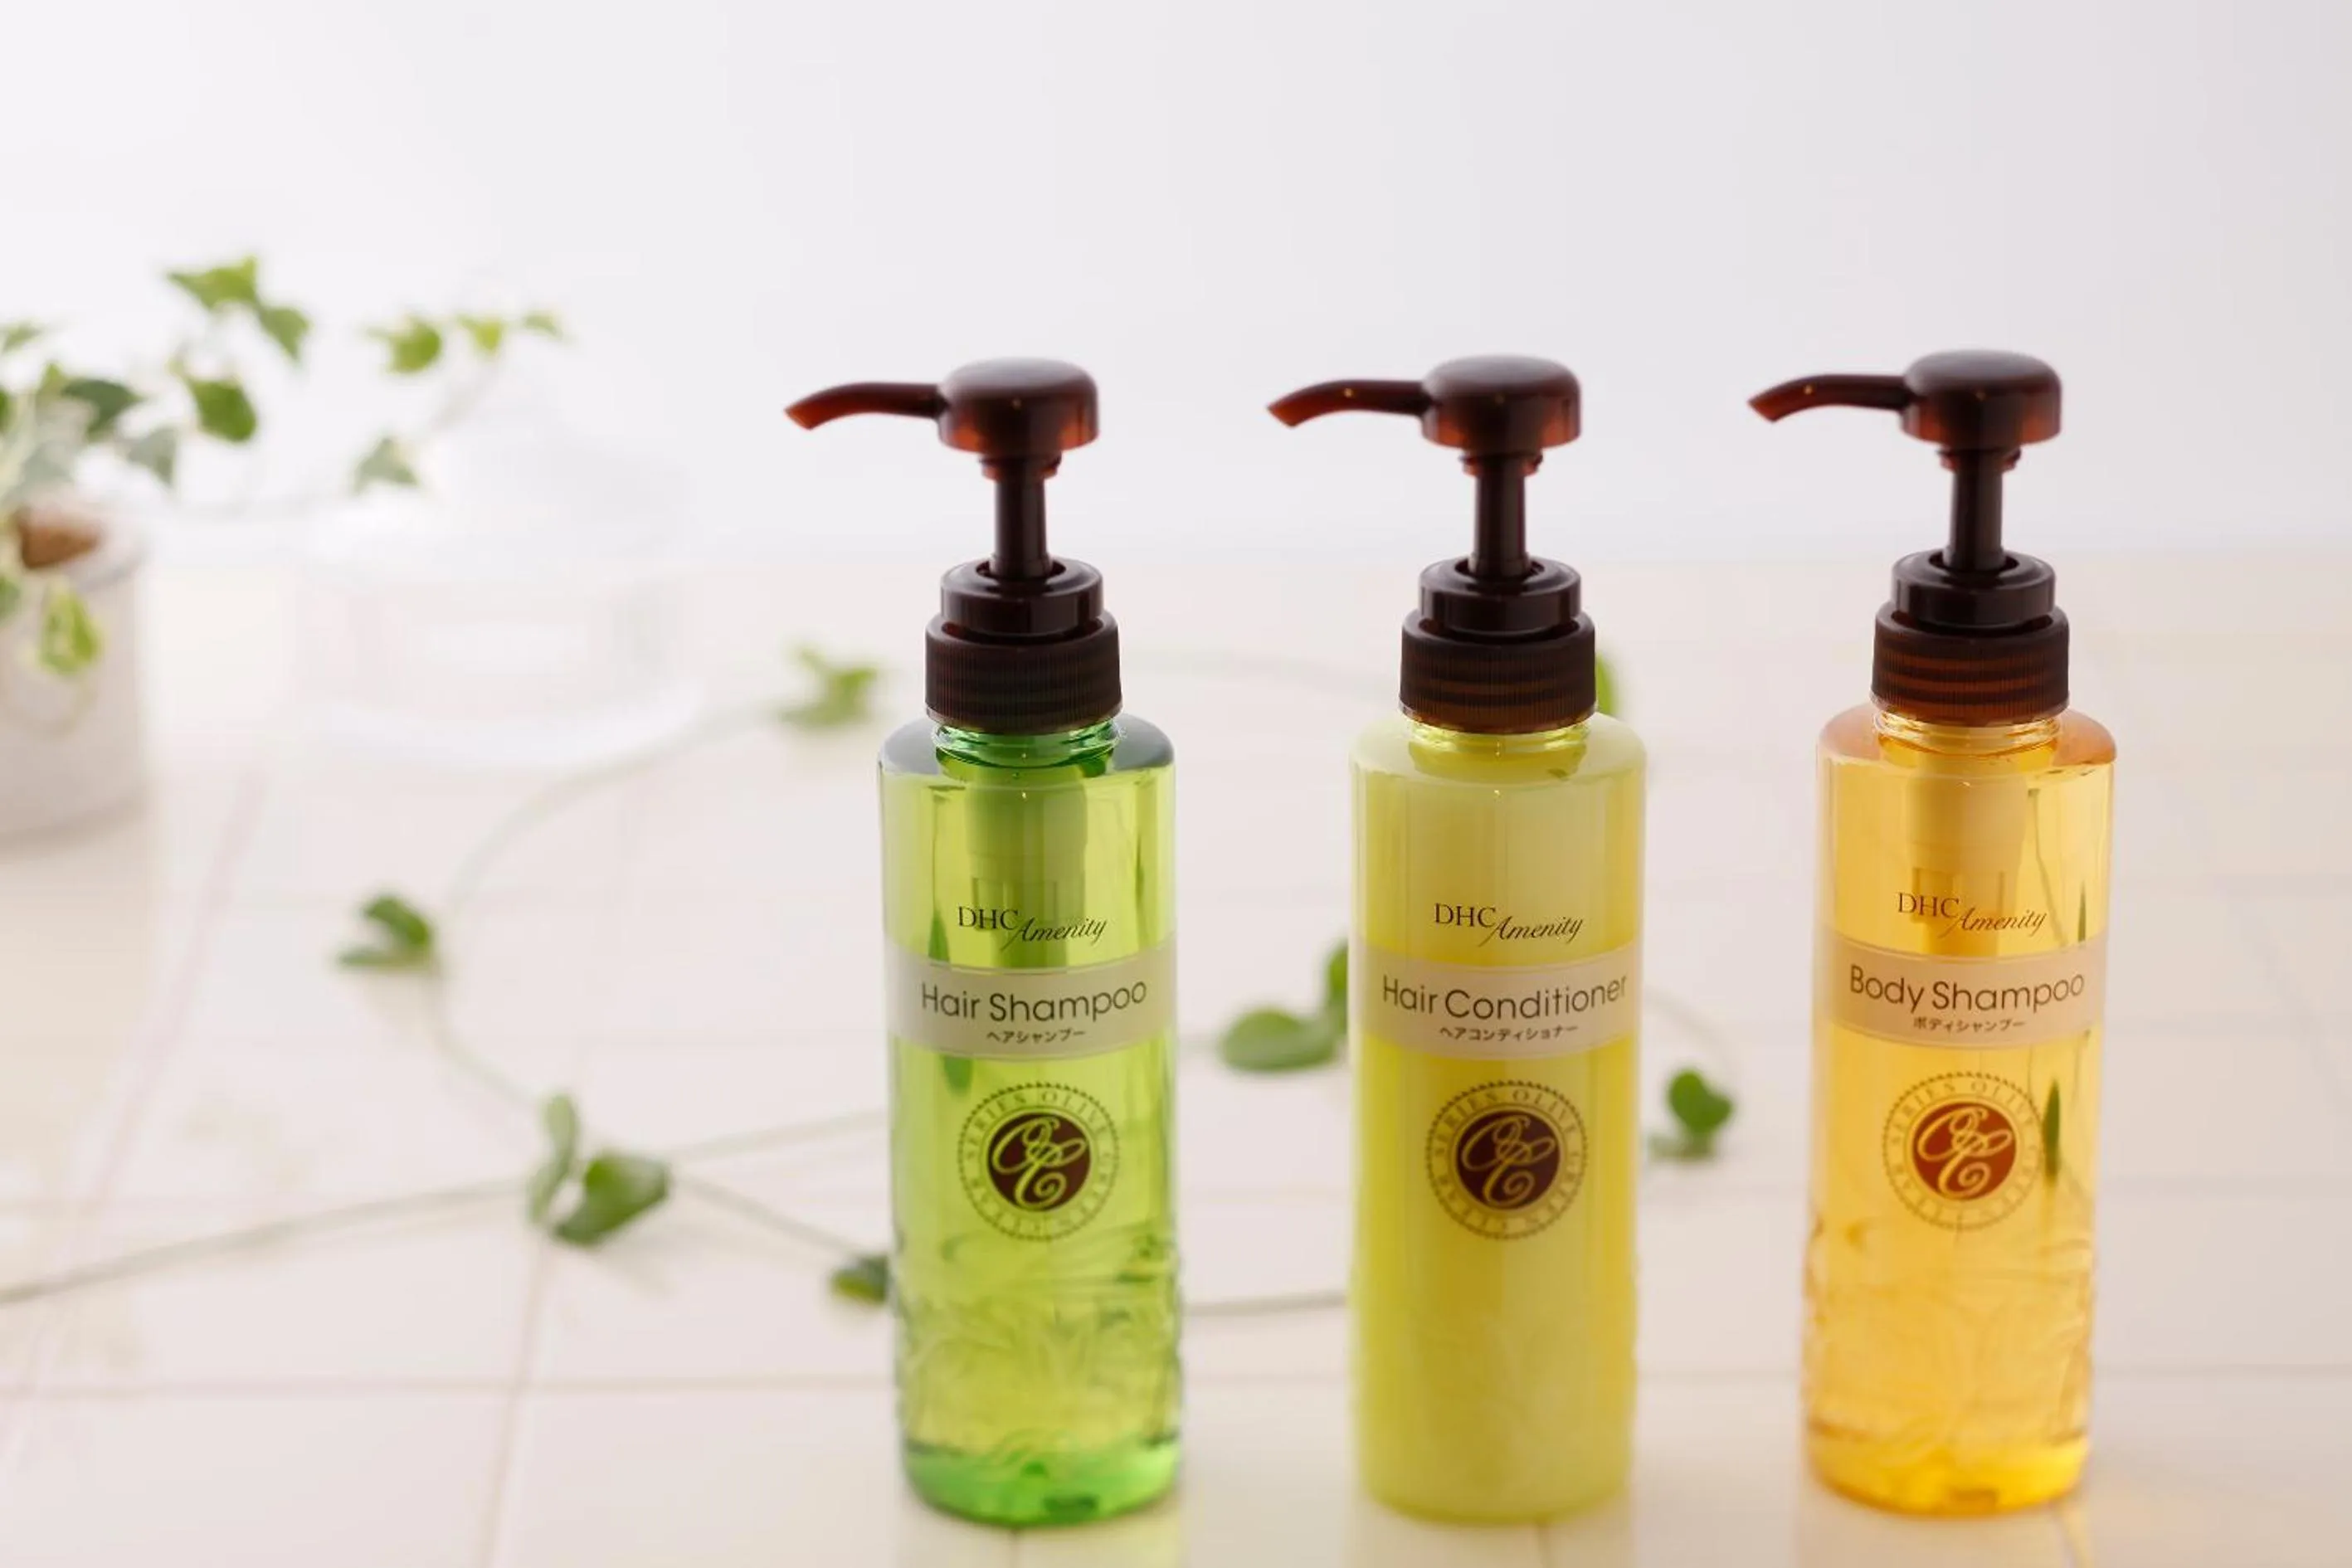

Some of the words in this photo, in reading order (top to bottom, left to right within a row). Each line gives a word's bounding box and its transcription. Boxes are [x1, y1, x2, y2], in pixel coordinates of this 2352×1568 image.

[958, 905, 1019, 931] DHC
[1000, 917, 1108, 952] Amenity
[1434, 902, 1497, 929] DHC
[1478, 915, 1585, 948] Amenity
[1897, 891, 1960, 918] DHC
[1937, 906, 2048, 940] Amenity
[921, 981, 981, 1021] Hair
[989, 981, 1147, 1023] Shampoo
[1382, 974, 1439, 1015] Hair
[1444, 974, 1629, 1021] Conditioner
[1849, 964, 1926, 1014] Body
[1931, 973, 2086, 1014] Shampoo
